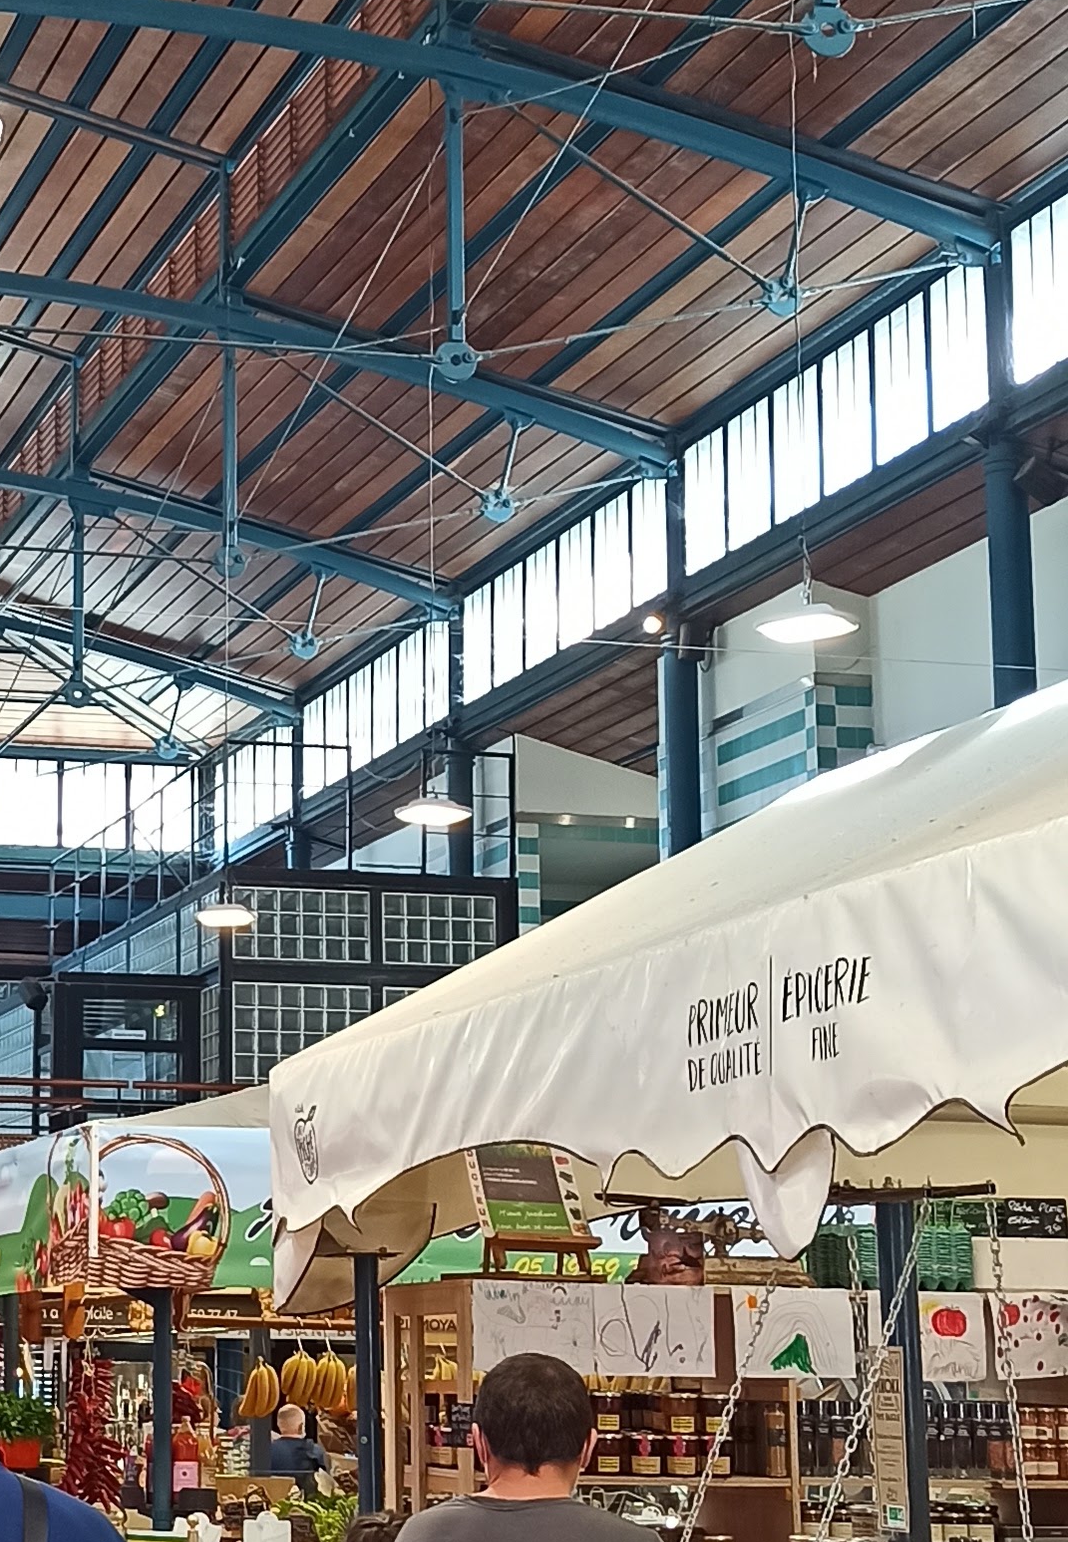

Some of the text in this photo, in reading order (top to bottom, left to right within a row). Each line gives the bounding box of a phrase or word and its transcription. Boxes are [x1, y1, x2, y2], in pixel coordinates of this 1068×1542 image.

[688, 982, 759, 1047] PRIMEUR
[782, 956, 871, 1022] ÉPICERIE
[688, 1037, 762, 1092] DE QUALITÉ
[812, 1022, 839, 1061] FINE
